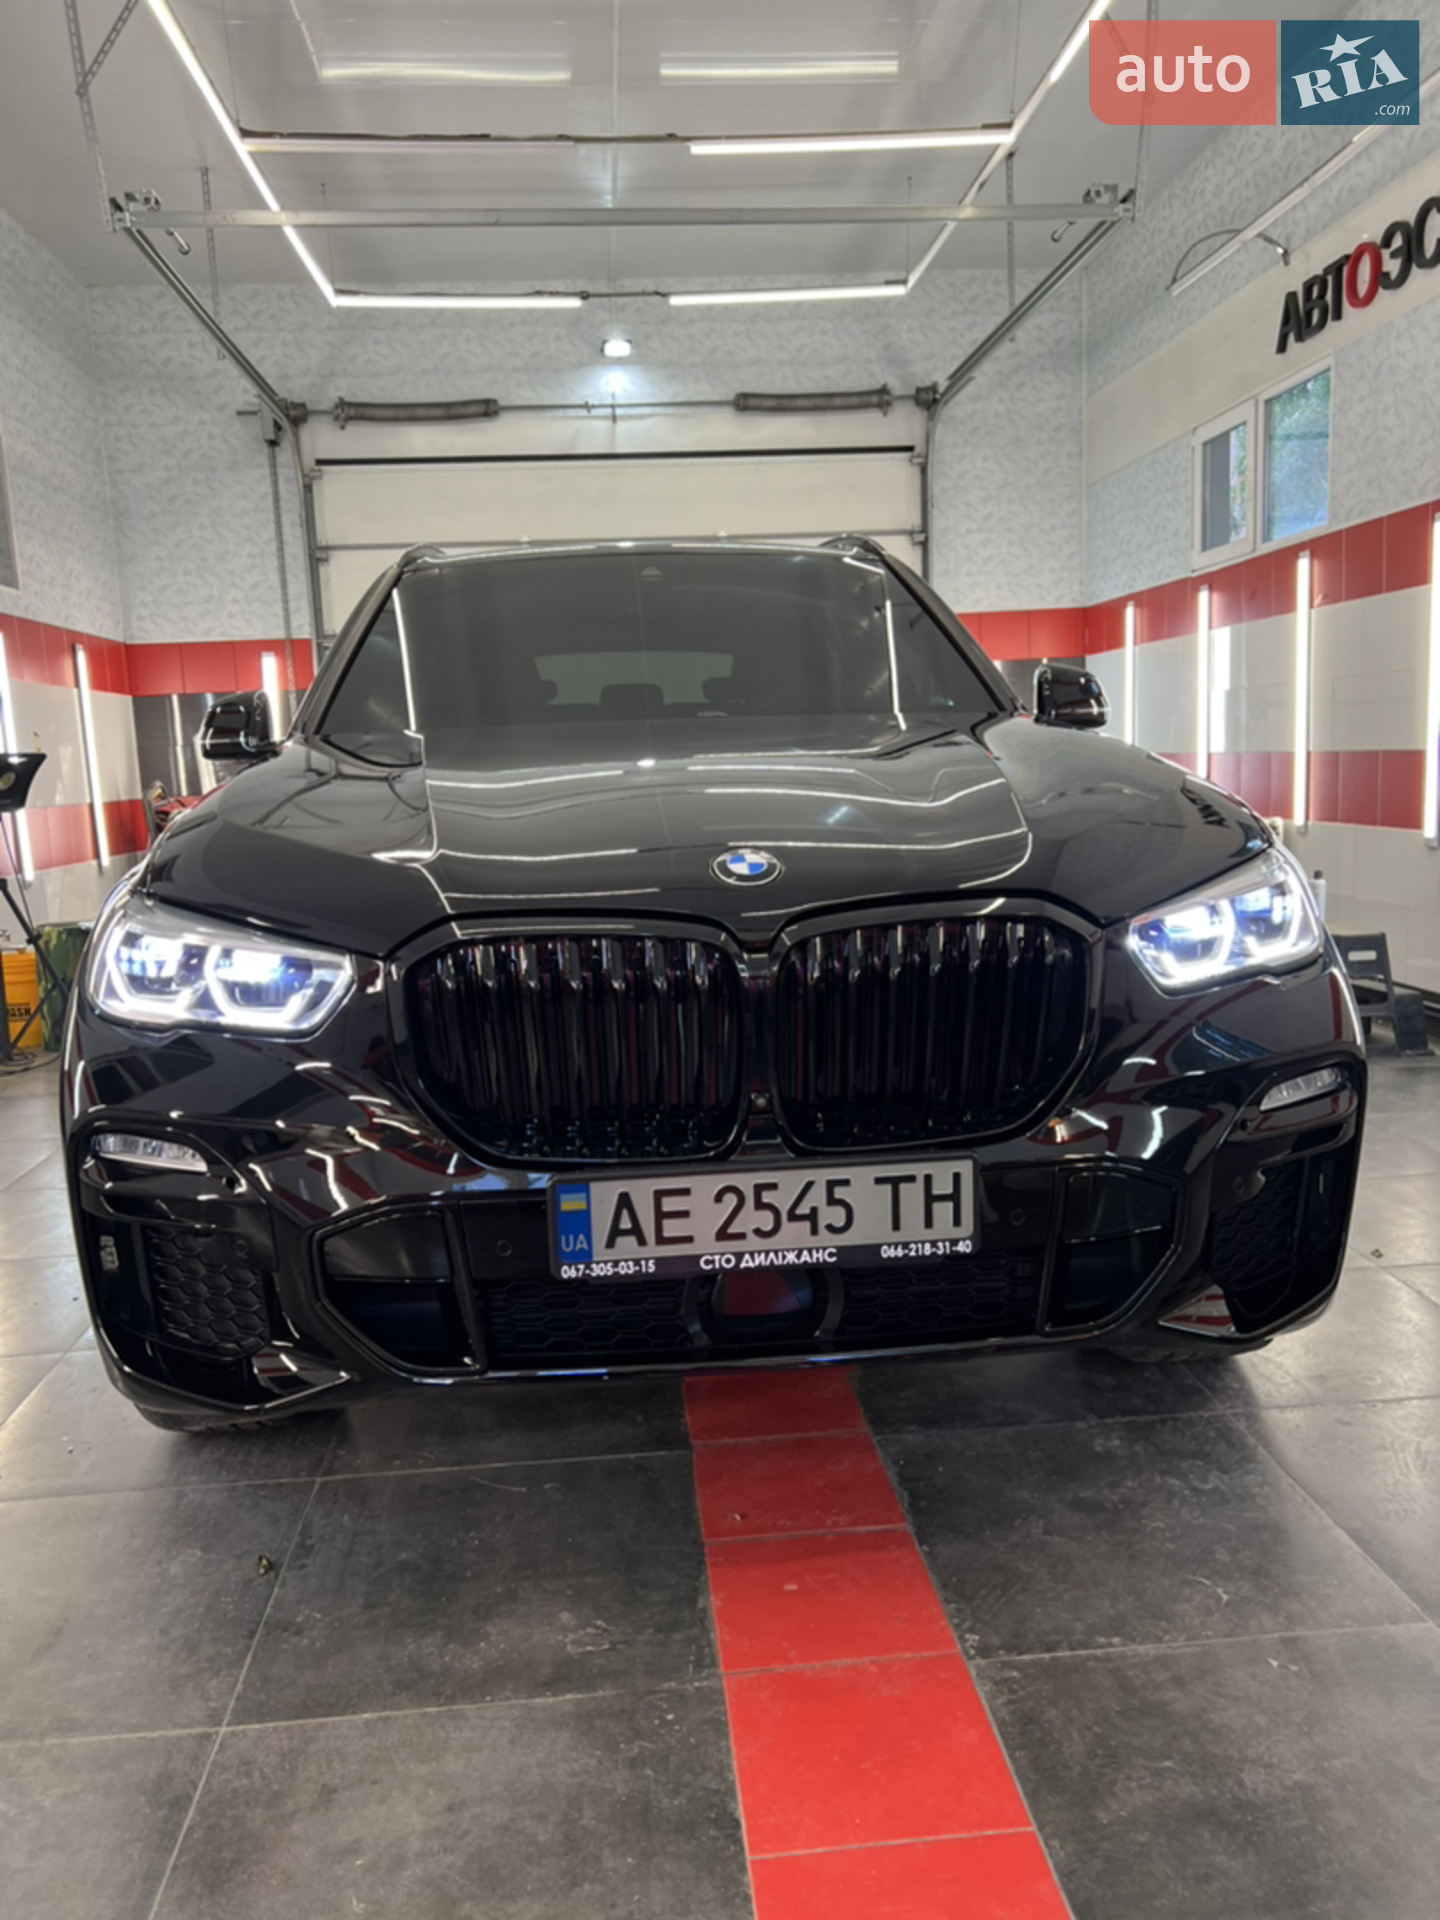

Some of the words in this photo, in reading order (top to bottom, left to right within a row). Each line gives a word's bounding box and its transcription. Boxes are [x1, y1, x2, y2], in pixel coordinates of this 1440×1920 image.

[1275, 196, 1440, 354] АВТОЭС
[605, 1190, 694, 1249] AE
[713, 1178, 854, 1242] 2545
[874, 1171, 962, 1231] TH
[561, 1234, 589, 1252] UA
[880, 1240, 973, 1258] 066-218-31-40
[560, 1259, 656, 1279] 067-305-03-15
[700, 1254, 736, 1270] СТО
